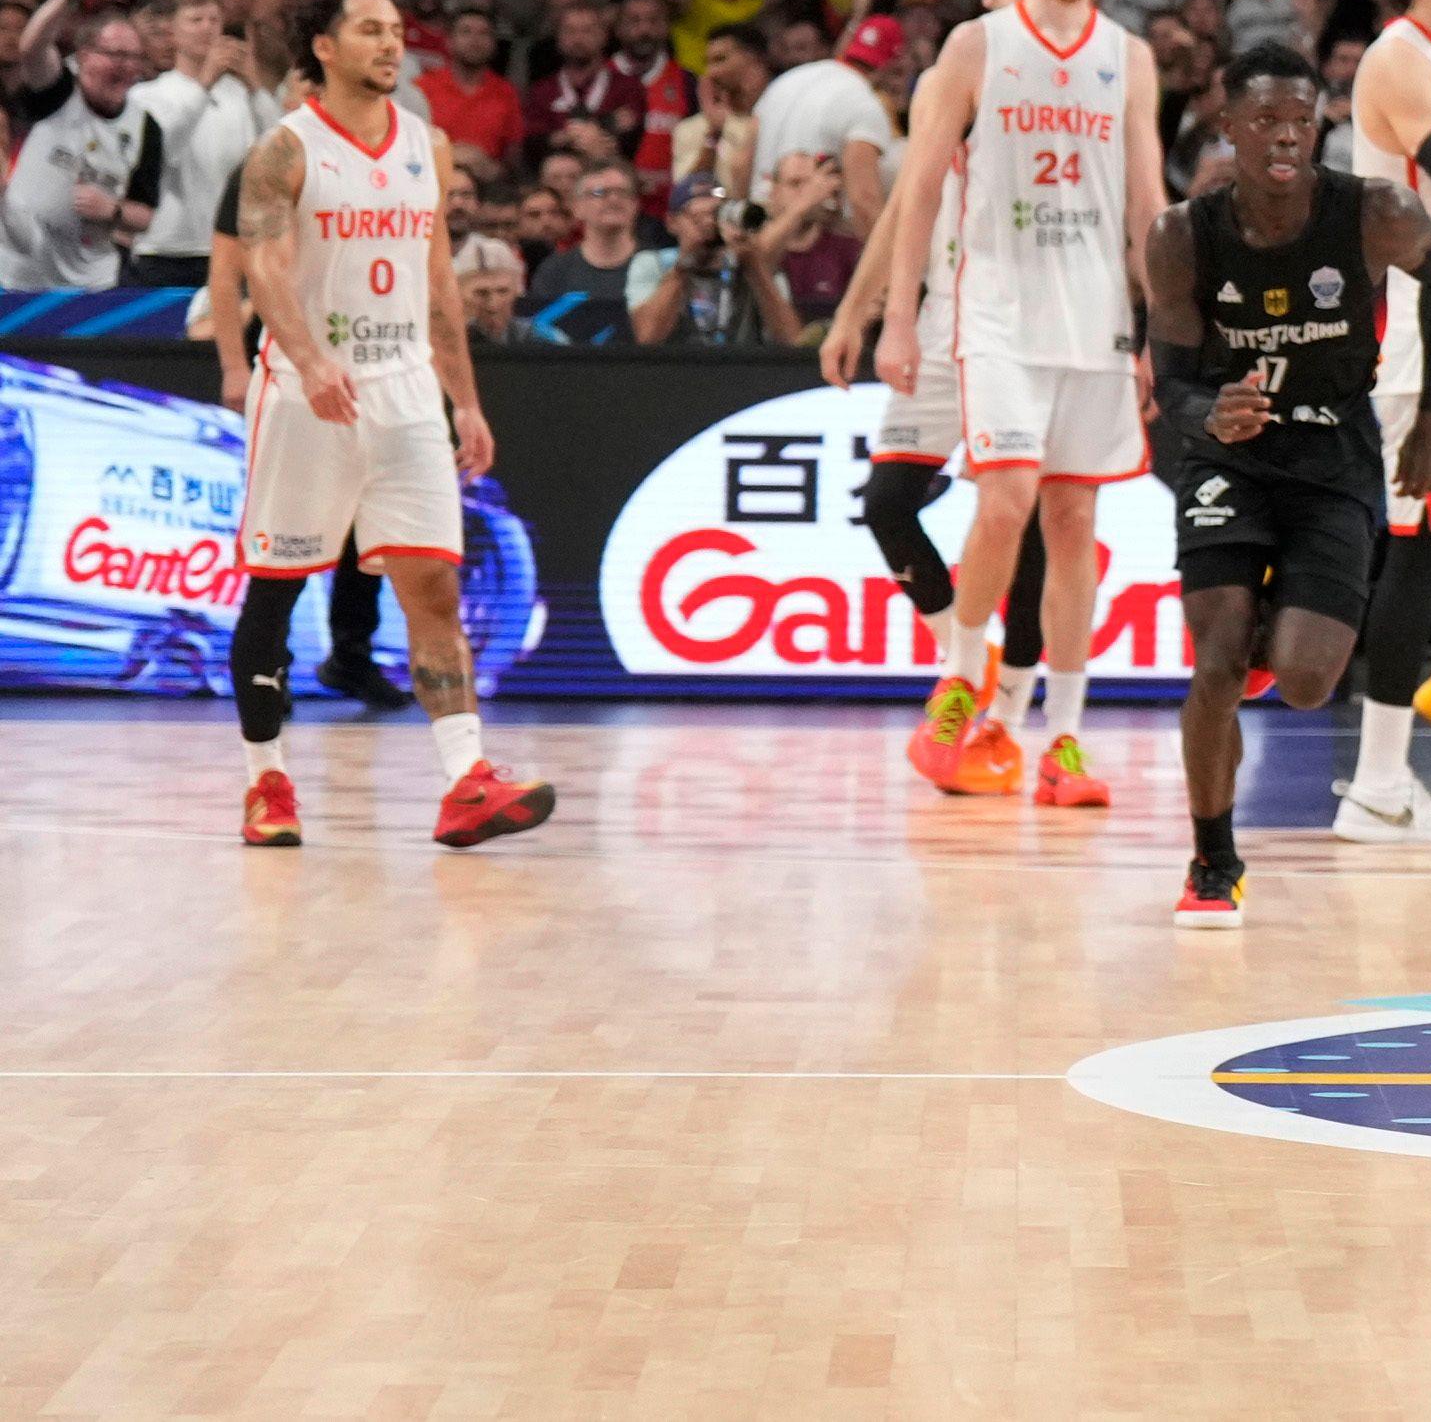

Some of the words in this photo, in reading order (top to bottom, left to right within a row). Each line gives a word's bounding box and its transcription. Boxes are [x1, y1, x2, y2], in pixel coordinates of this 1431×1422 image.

[998, 98, 1115, 143] TÜRKİYE
[1034, 149, 1083, 186] 24
[314, 202, 434, 241] TÜRKİYE
[368, 258, 396, 296] 0
